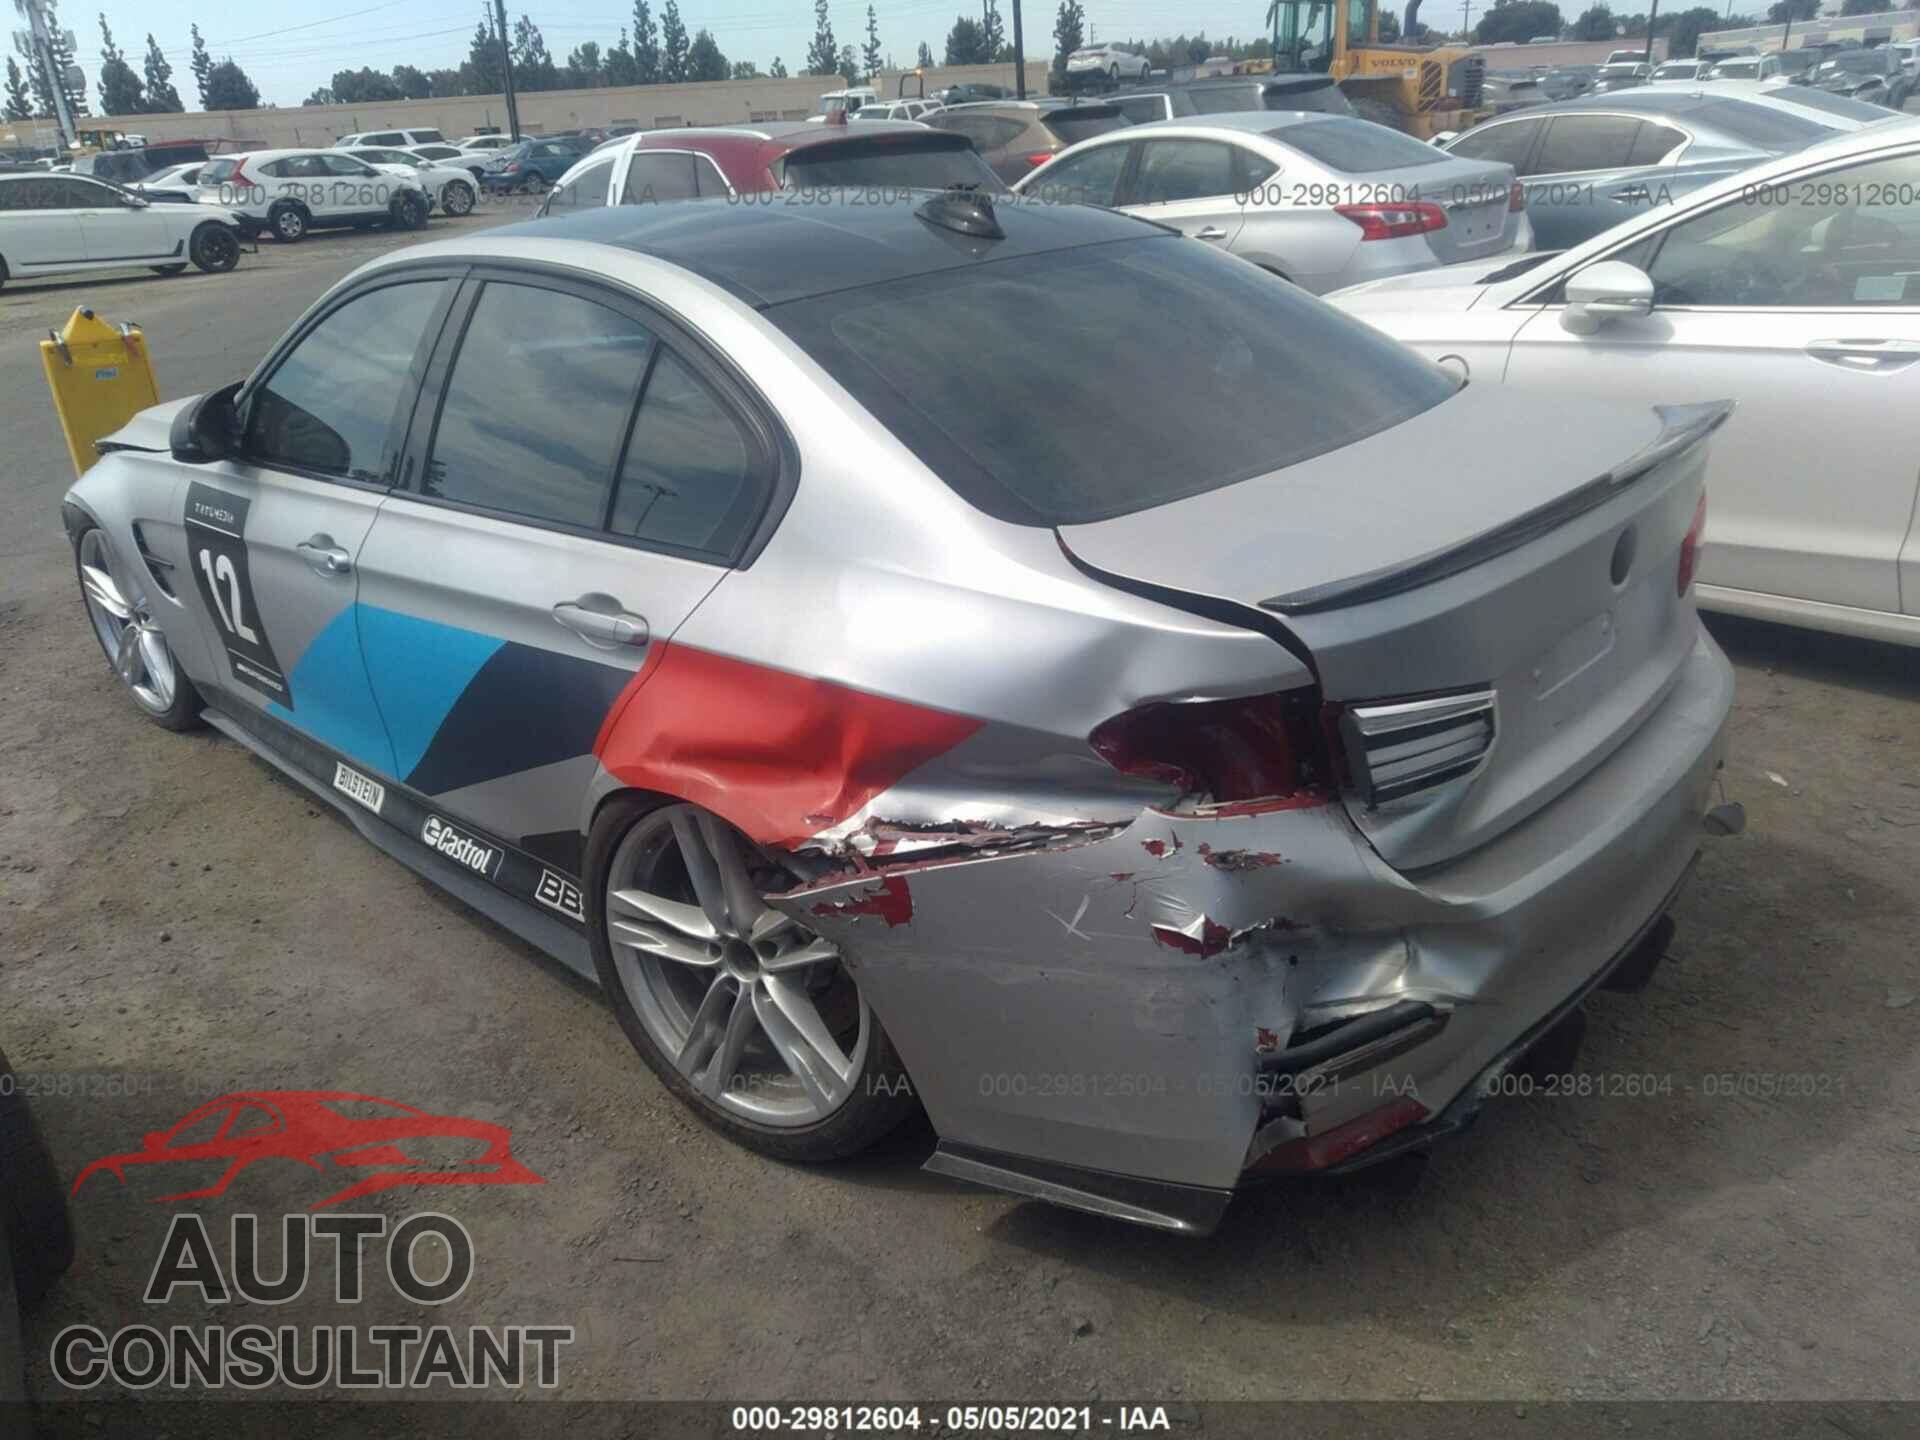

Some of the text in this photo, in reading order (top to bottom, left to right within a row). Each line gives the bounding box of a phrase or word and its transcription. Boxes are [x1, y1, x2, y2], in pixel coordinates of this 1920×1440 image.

[1371, 58, 1416, 67] VOLVO
[199, 548, 259, 645] 12
[338, 767, 381, 807] BILSTEIN
[437, 826, 492, 874] Castrol
